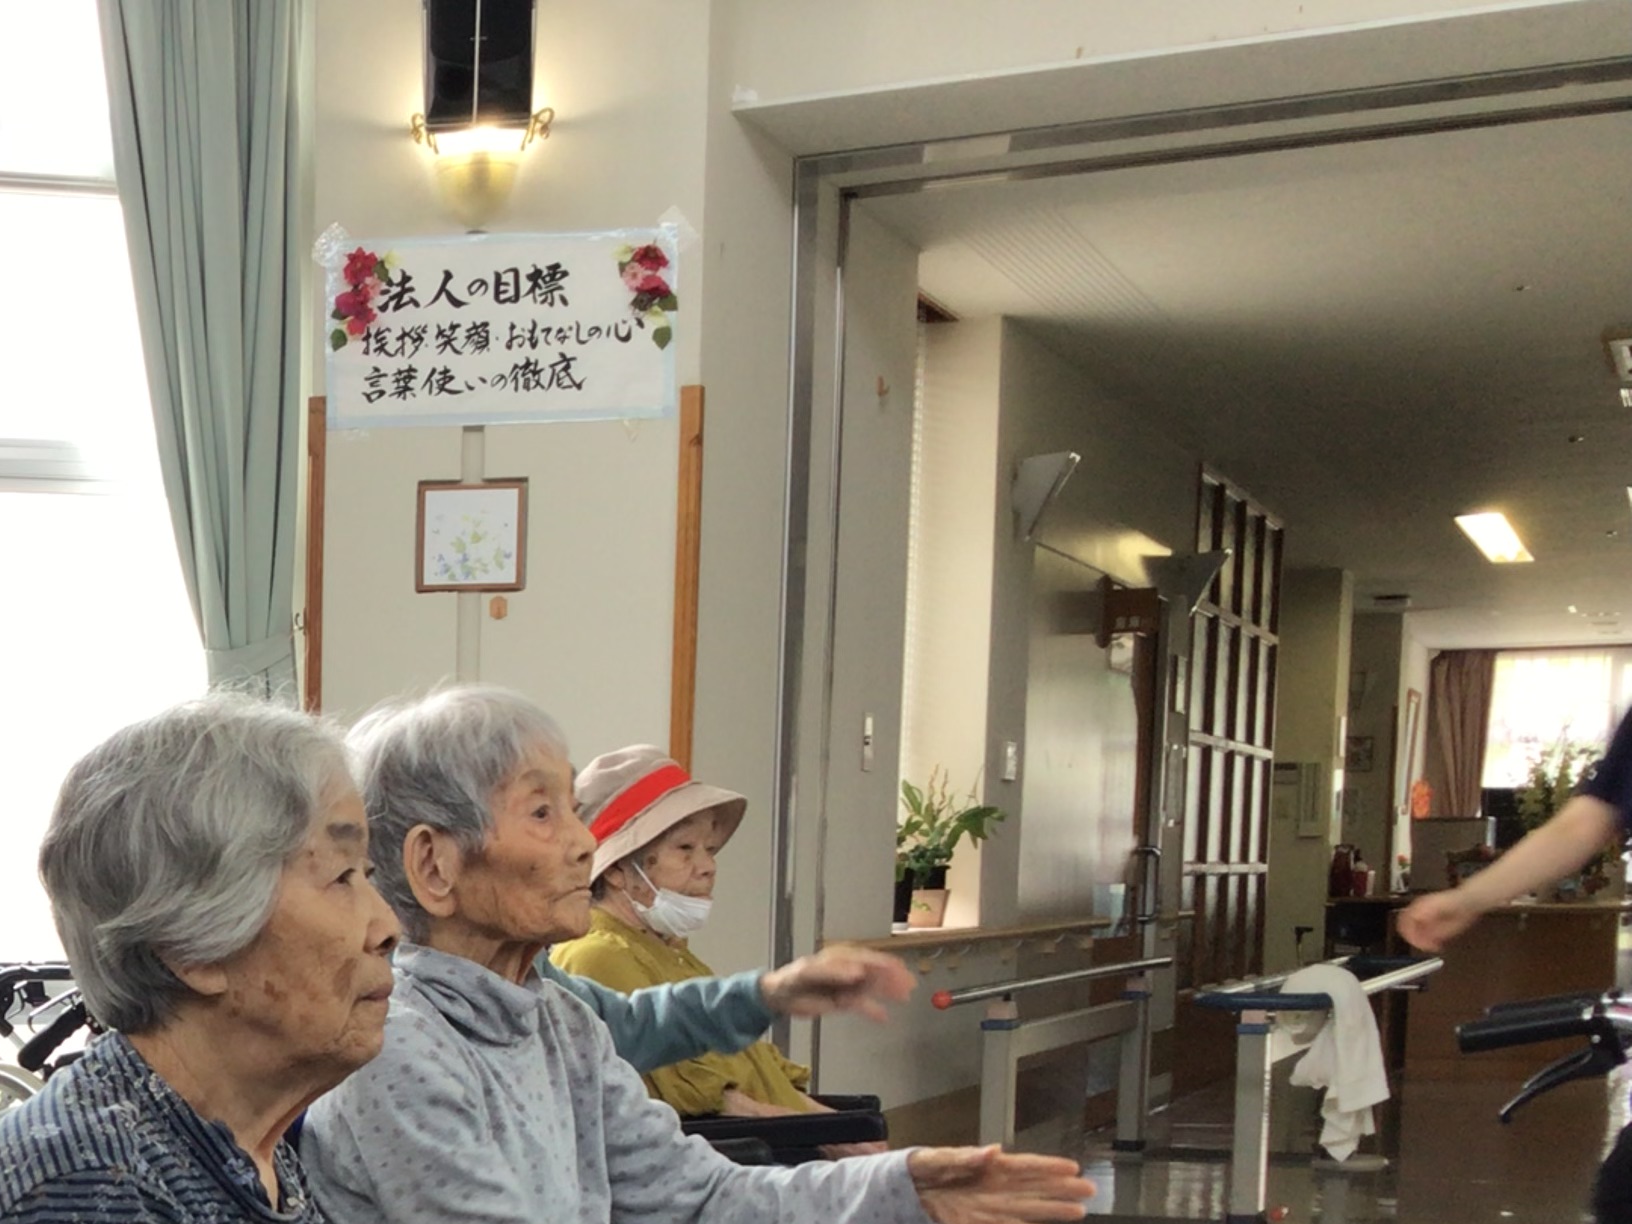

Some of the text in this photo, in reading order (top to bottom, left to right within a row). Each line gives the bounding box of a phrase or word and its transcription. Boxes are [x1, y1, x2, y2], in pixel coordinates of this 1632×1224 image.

[377, 262, 570, 313] 法人の目標
[361, 352, 587, 403] 言葉使いの徹底
